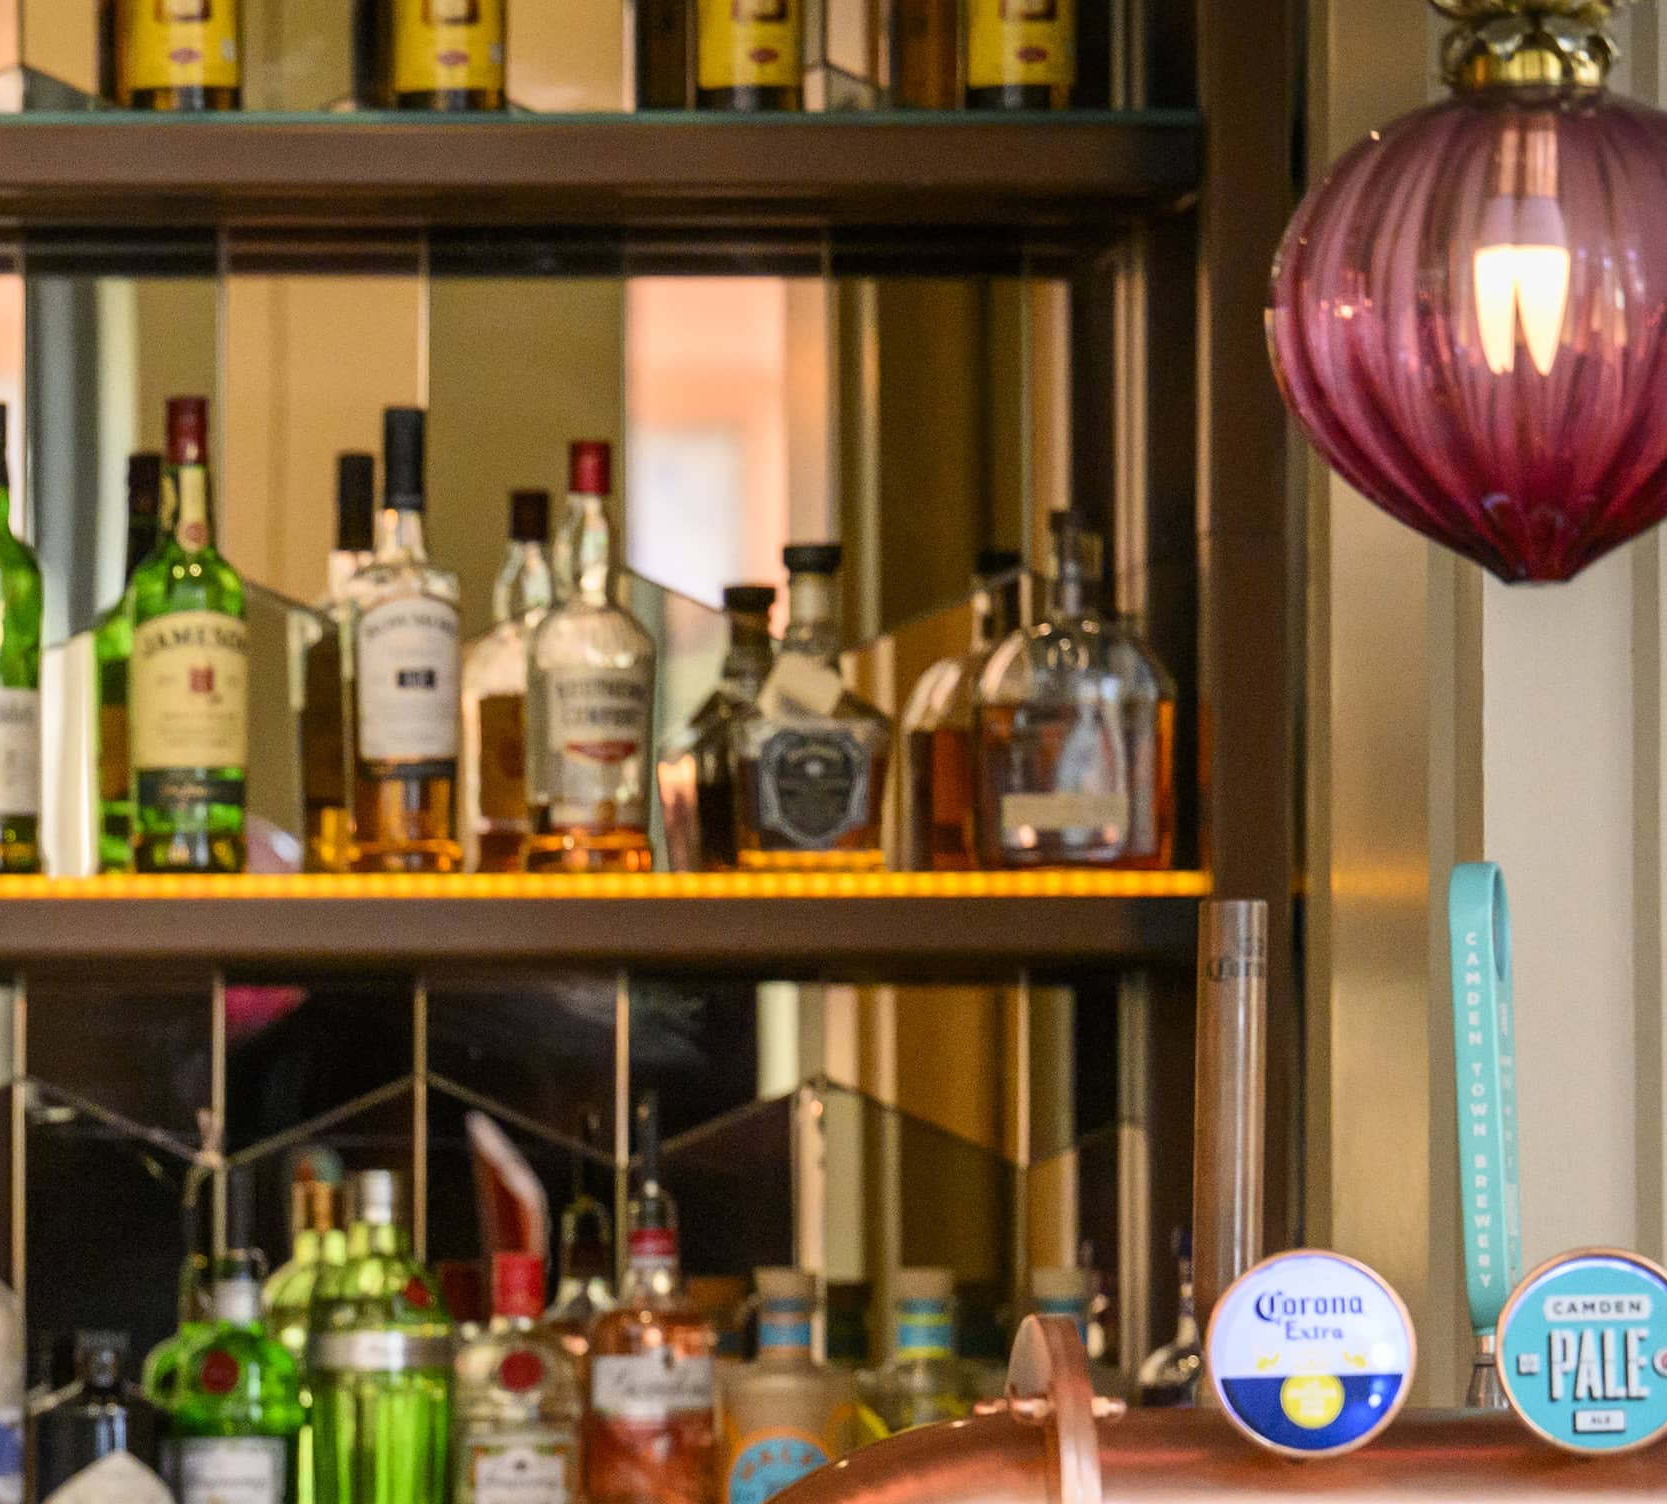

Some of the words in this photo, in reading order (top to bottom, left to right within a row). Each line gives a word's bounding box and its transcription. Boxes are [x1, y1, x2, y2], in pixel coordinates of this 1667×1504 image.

[1464, 931, 1482, 1046] CAMDEN
[1470, 1062, 1489, 1137] TOWN
[1473, 1153, 1492, 1288] BREWERY
[1254, 1289, 1364, 1326] Corona
[1284, 1320, 1345, 1341] Extra
[1552, 1301, 1643, 1316] CAMDEN
[1548, 1327, 1651, 1402] PALE
[1590, 1415, 1612, 1426] ALE
